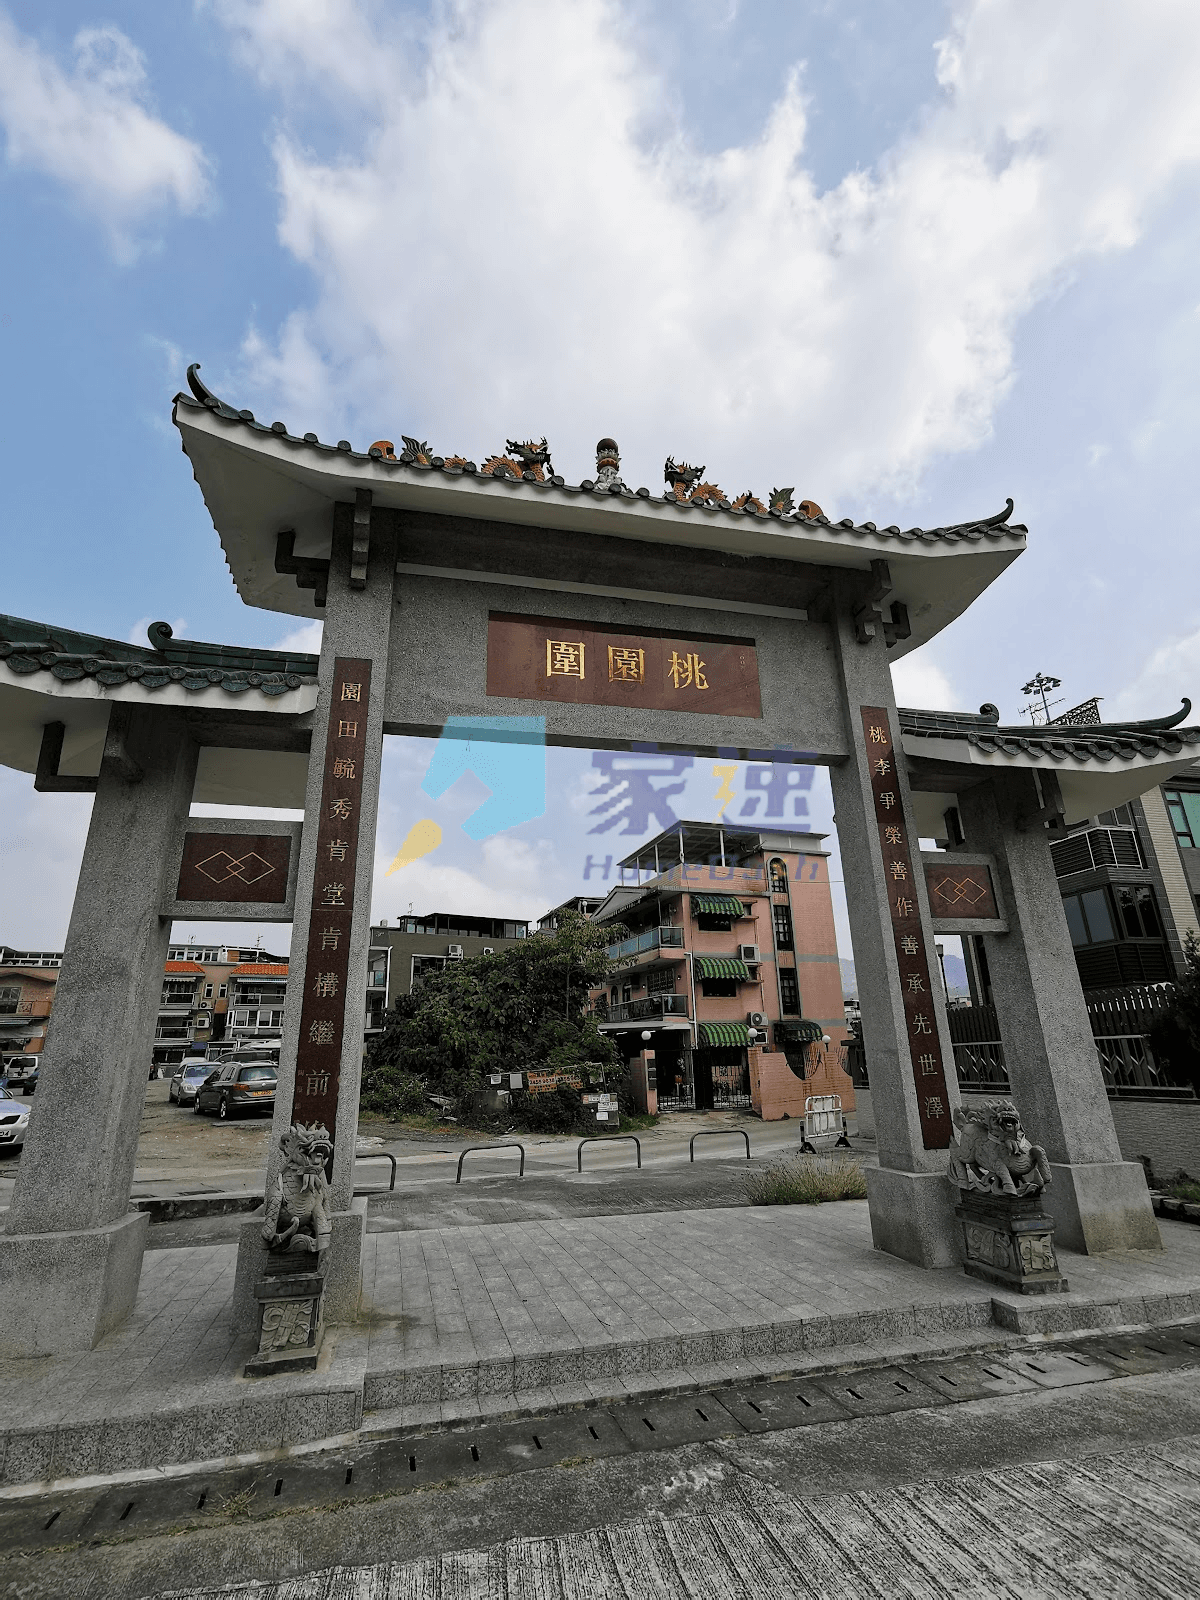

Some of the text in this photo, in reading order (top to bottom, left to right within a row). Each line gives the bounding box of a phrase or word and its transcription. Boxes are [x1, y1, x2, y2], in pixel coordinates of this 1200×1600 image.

[305, 681, 362, 1132] 園田毓秀肯堂肯構繼前
